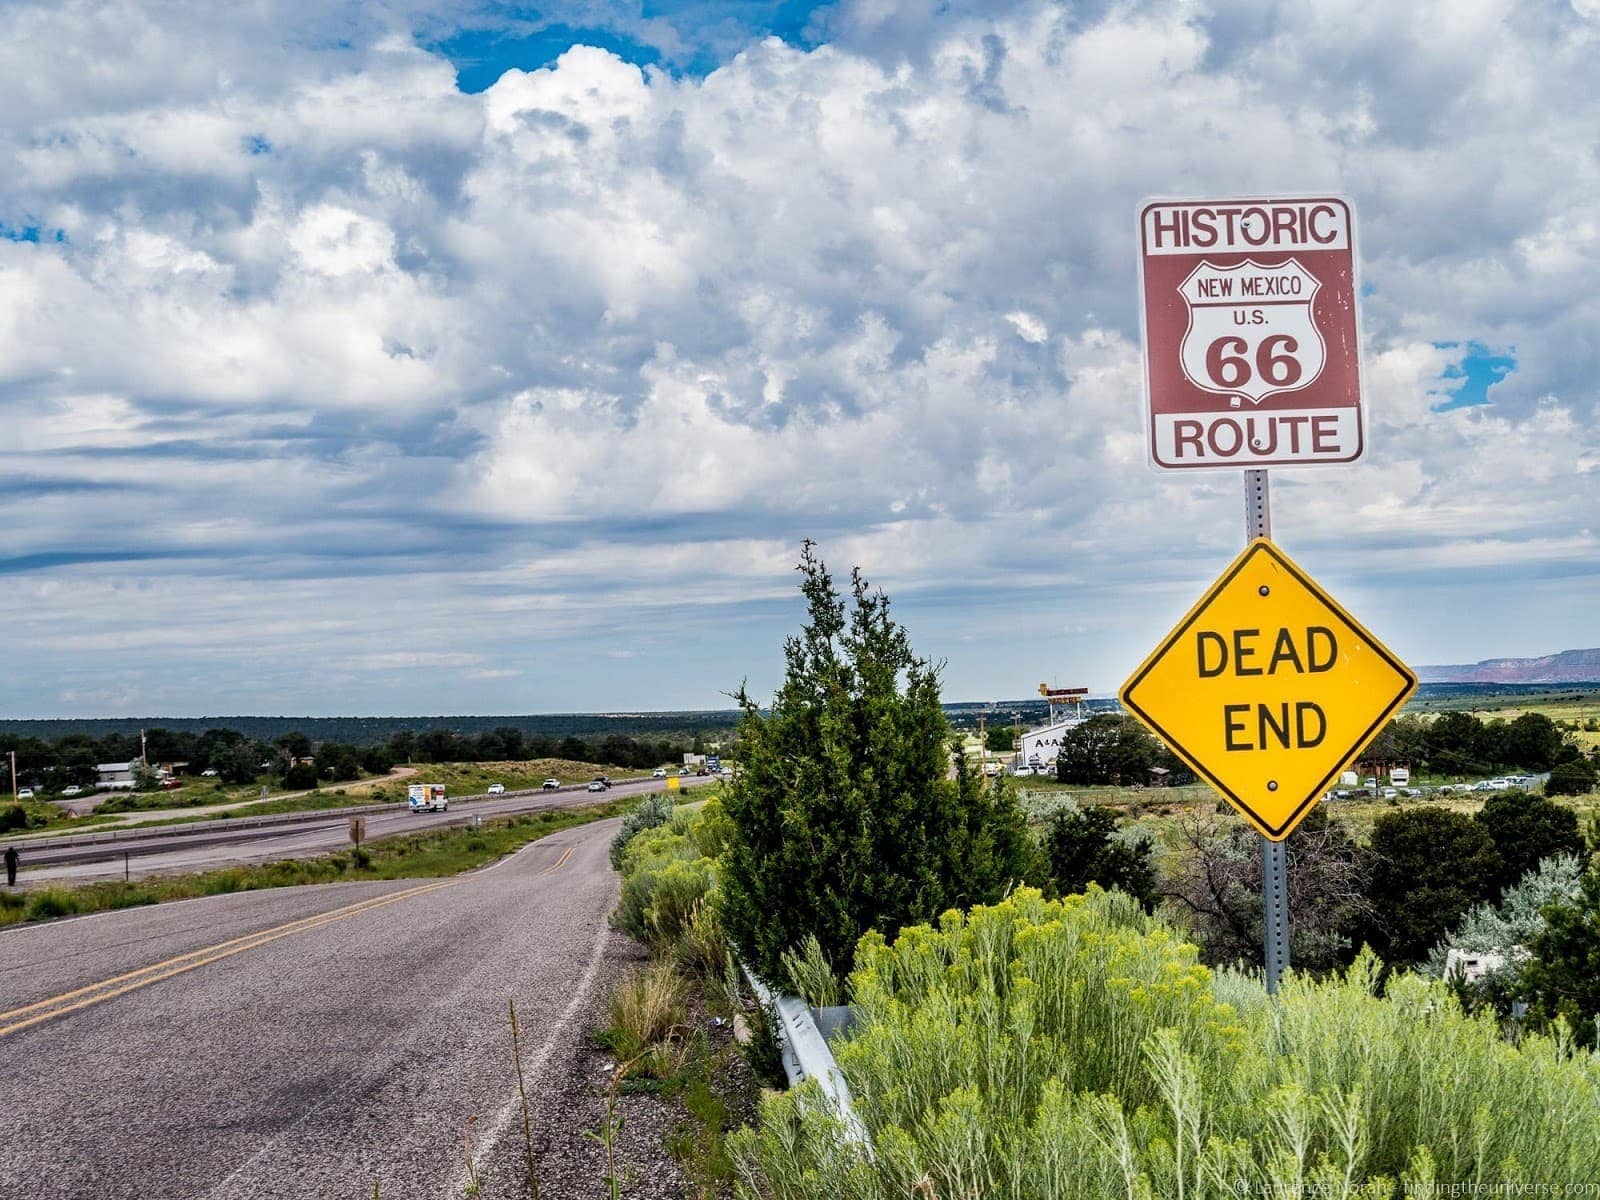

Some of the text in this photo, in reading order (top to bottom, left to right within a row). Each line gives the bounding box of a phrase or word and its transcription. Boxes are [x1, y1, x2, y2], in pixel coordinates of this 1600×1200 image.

[1154, 205, 1338, 248] HISTORIC
[1198, 276, 1301, 298] NEW MEXICO
[1233, 310, 1269, 325] U.S.
[1206, 334, 1302, 388] 66
[1173, 415, 1341, 458] ROUTE
[1197, 626, 1338, 678] DEAD
[1224, 702, 1327, 751] END
